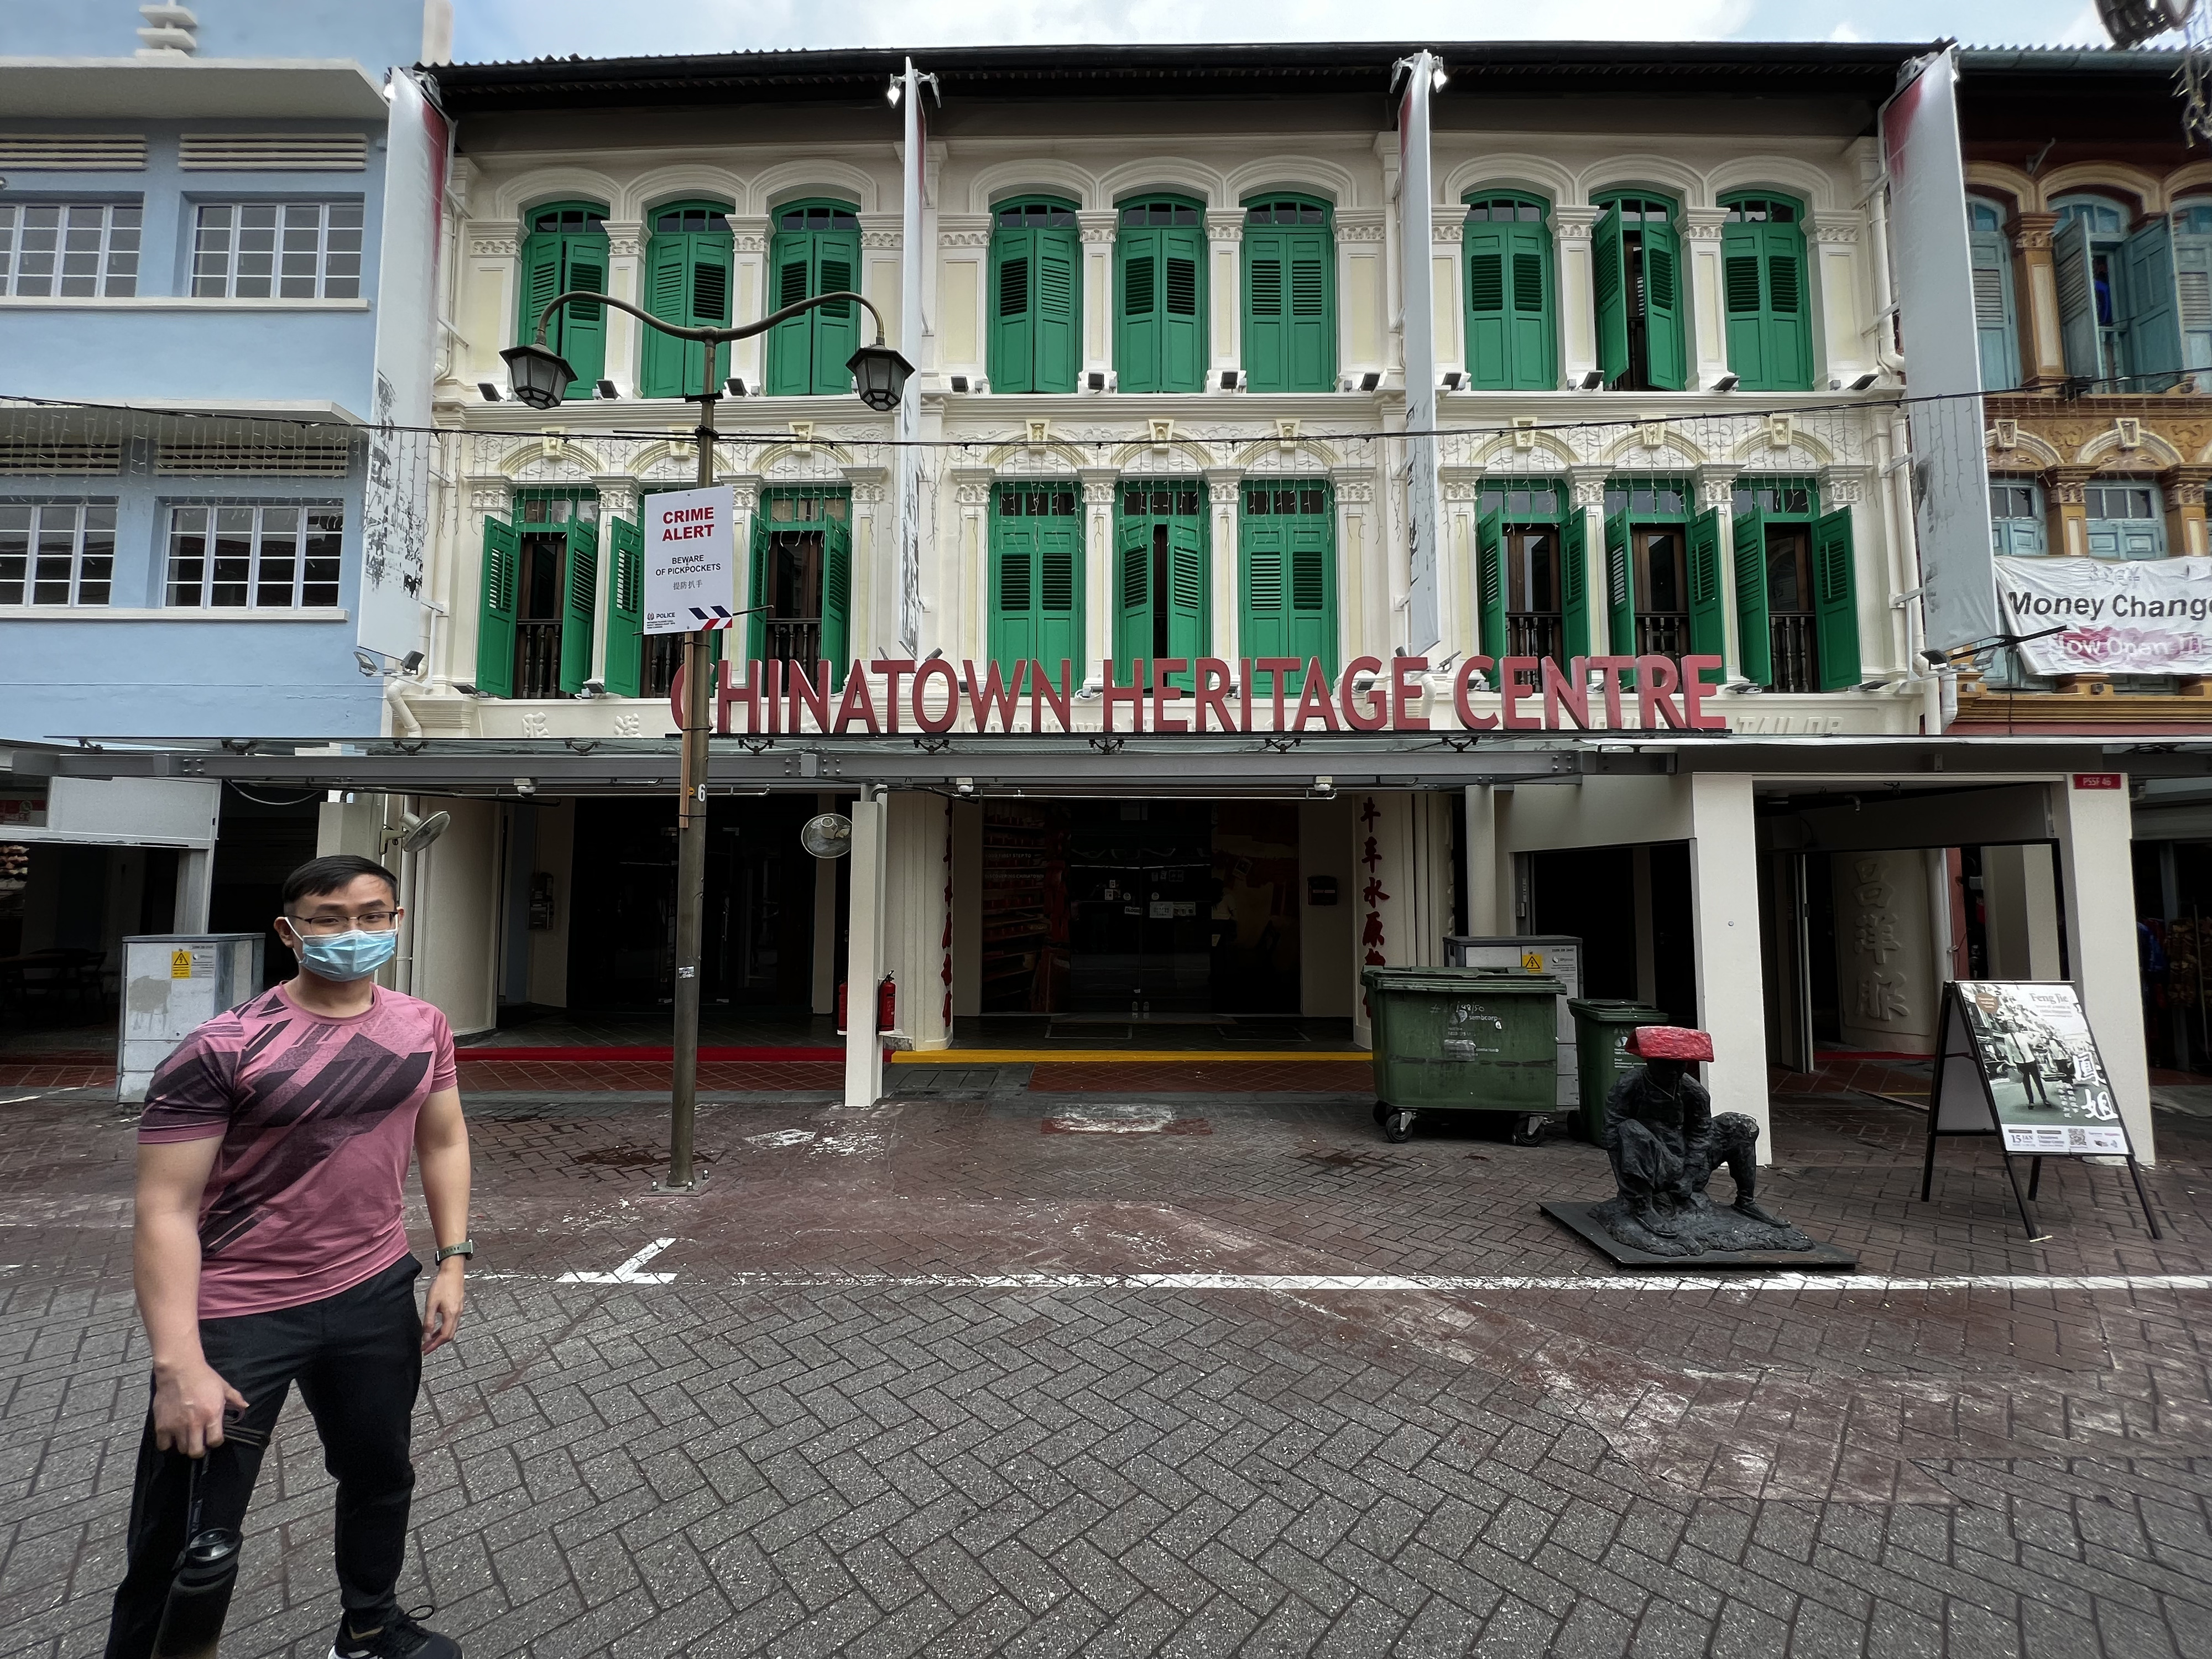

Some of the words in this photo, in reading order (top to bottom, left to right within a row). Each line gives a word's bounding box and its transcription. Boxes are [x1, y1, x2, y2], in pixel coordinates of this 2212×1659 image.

[662, 507, 714, 524] CRIME
[662, 524, 714, 541] ALERT
[672, 555, 704, 565] BEWARE
[667, 564, 721, 575] PICKPOCKETS
[2008, 592, 2104, 620] Money
[2112, 594, 2212, 621] Chang
[671, 658, 1072, 733] CHINATOWN
[1103, 655, 1430, 732] HERITAGE
[1454, 654, 1726, 730] CENTRE
[698, 783, 706, 802] 6
